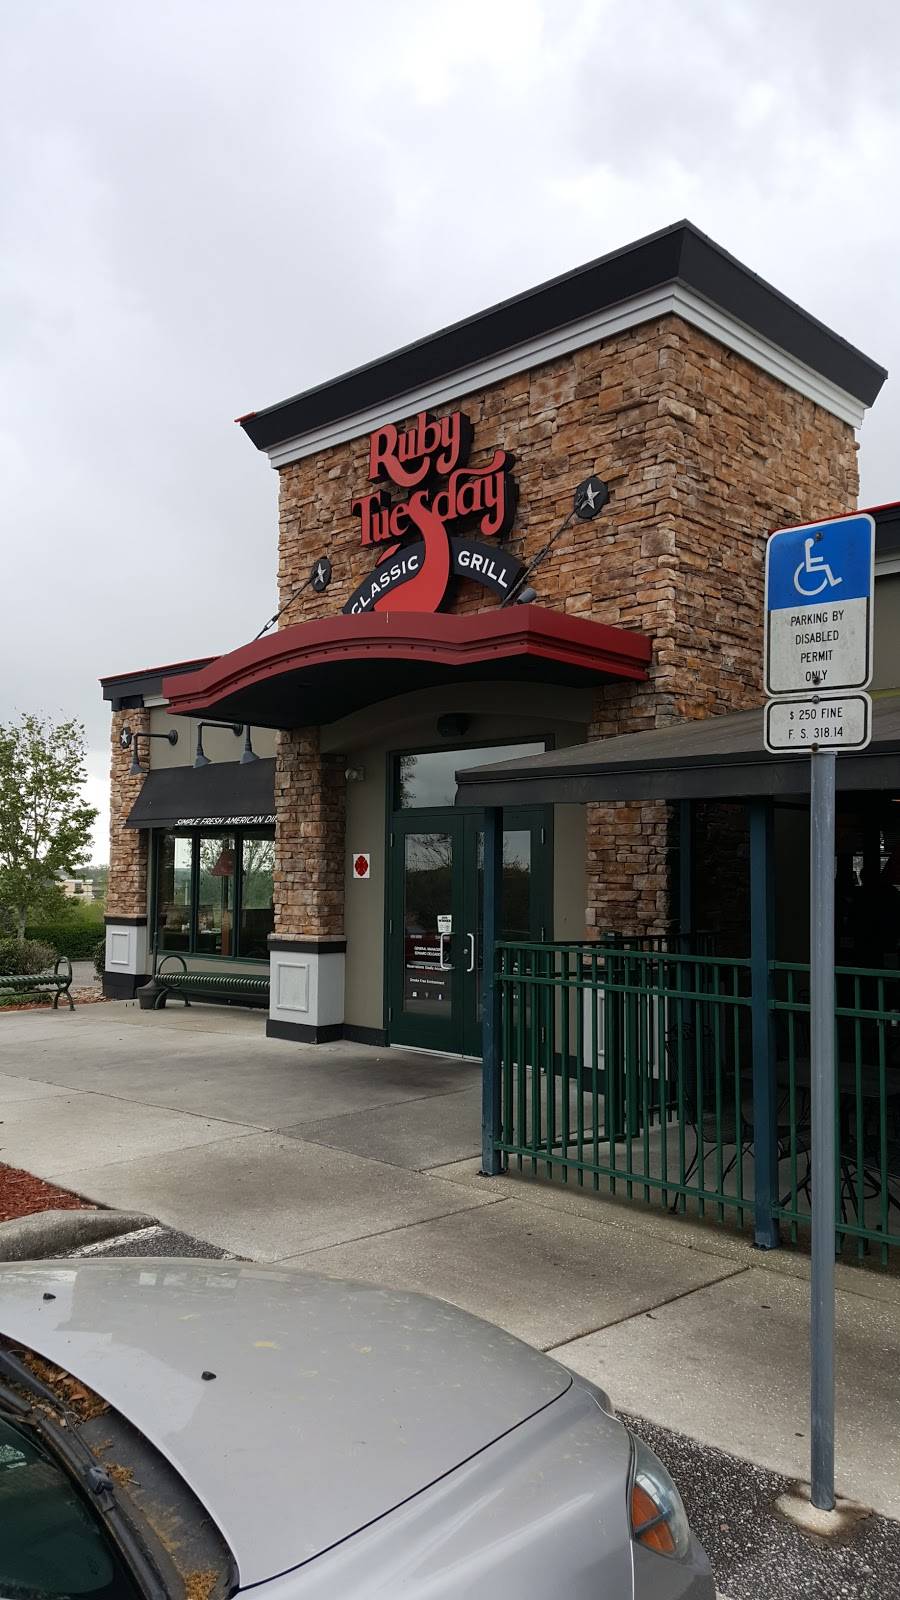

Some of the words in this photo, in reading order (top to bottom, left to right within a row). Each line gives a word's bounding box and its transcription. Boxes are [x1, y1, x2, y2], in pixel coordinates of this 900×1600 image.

[368, 411, 461, 488] Ruby
[351, 450, 507, 578] Tuesday
[351, 555, 420, 615] CLASSIC
[457, 550, 508, 589] GRILL
[790, 611, 828, 627] PARKING
[832, 609, 845, 621] BY
[795, 630, 840, 645] DISABLED
[800, 650, 833, 664] PERMIT
[805, 669, 828, 682] ONLY
[798, 708, 817, 720] 250
[821, 707, 843, 719] FINE
[814, 726, 844, 738] 318.14
[175, 818, 201, 826] SIMPLE
[201, 817, 225, 825] FRESH
[224, 815, 264, 825] AMERICAN
